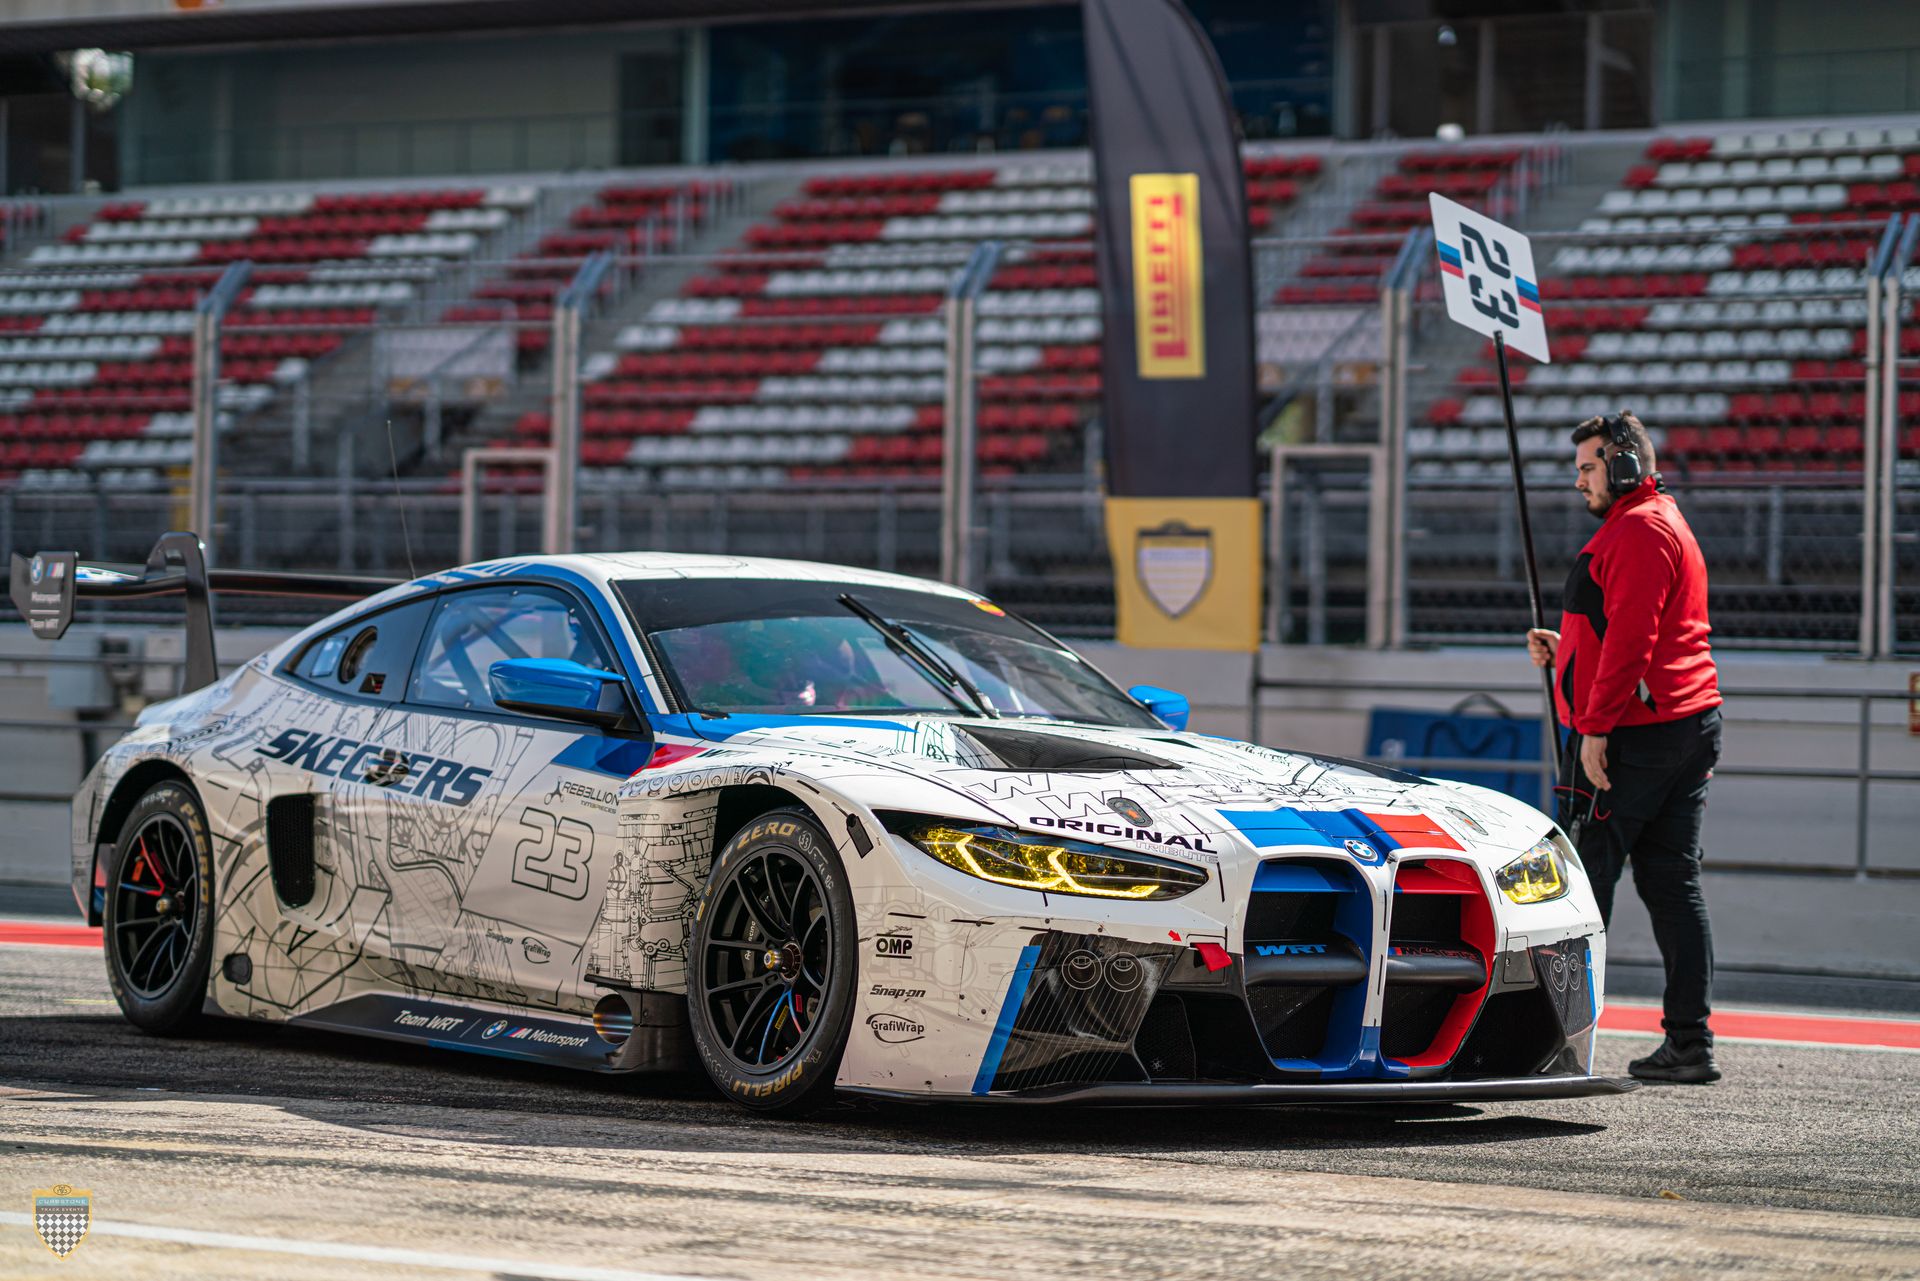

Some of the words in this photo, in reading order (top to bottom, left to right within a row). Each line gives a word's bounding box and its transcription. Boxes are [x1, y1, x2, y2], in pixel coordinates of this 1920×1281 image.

[1149, 193, 1187, 359] PIRELLI
[1459, 221, 1520, 329] 23
[736, 821, 797, 850] ZERO
[1029, 816, 1218, 854] ORIGINAL
[511, 806, 596, 901] 23
[1134, 840, 1219, 864] TRIBUTE
[876, 938, 913, 955] OMP
[1255, 944, 1328, 957] WRT
[870, 984, 927, 999] Snap-on
[394, 1010, 428, 1026] Team
[427, 1015, 465, 1031] WRT
[870, 1019, 925, 1035] GrafiWrap
[528, 1029, 589, 1047] Motorsport
[732, 1060, 804, 1097] PIRELLI
